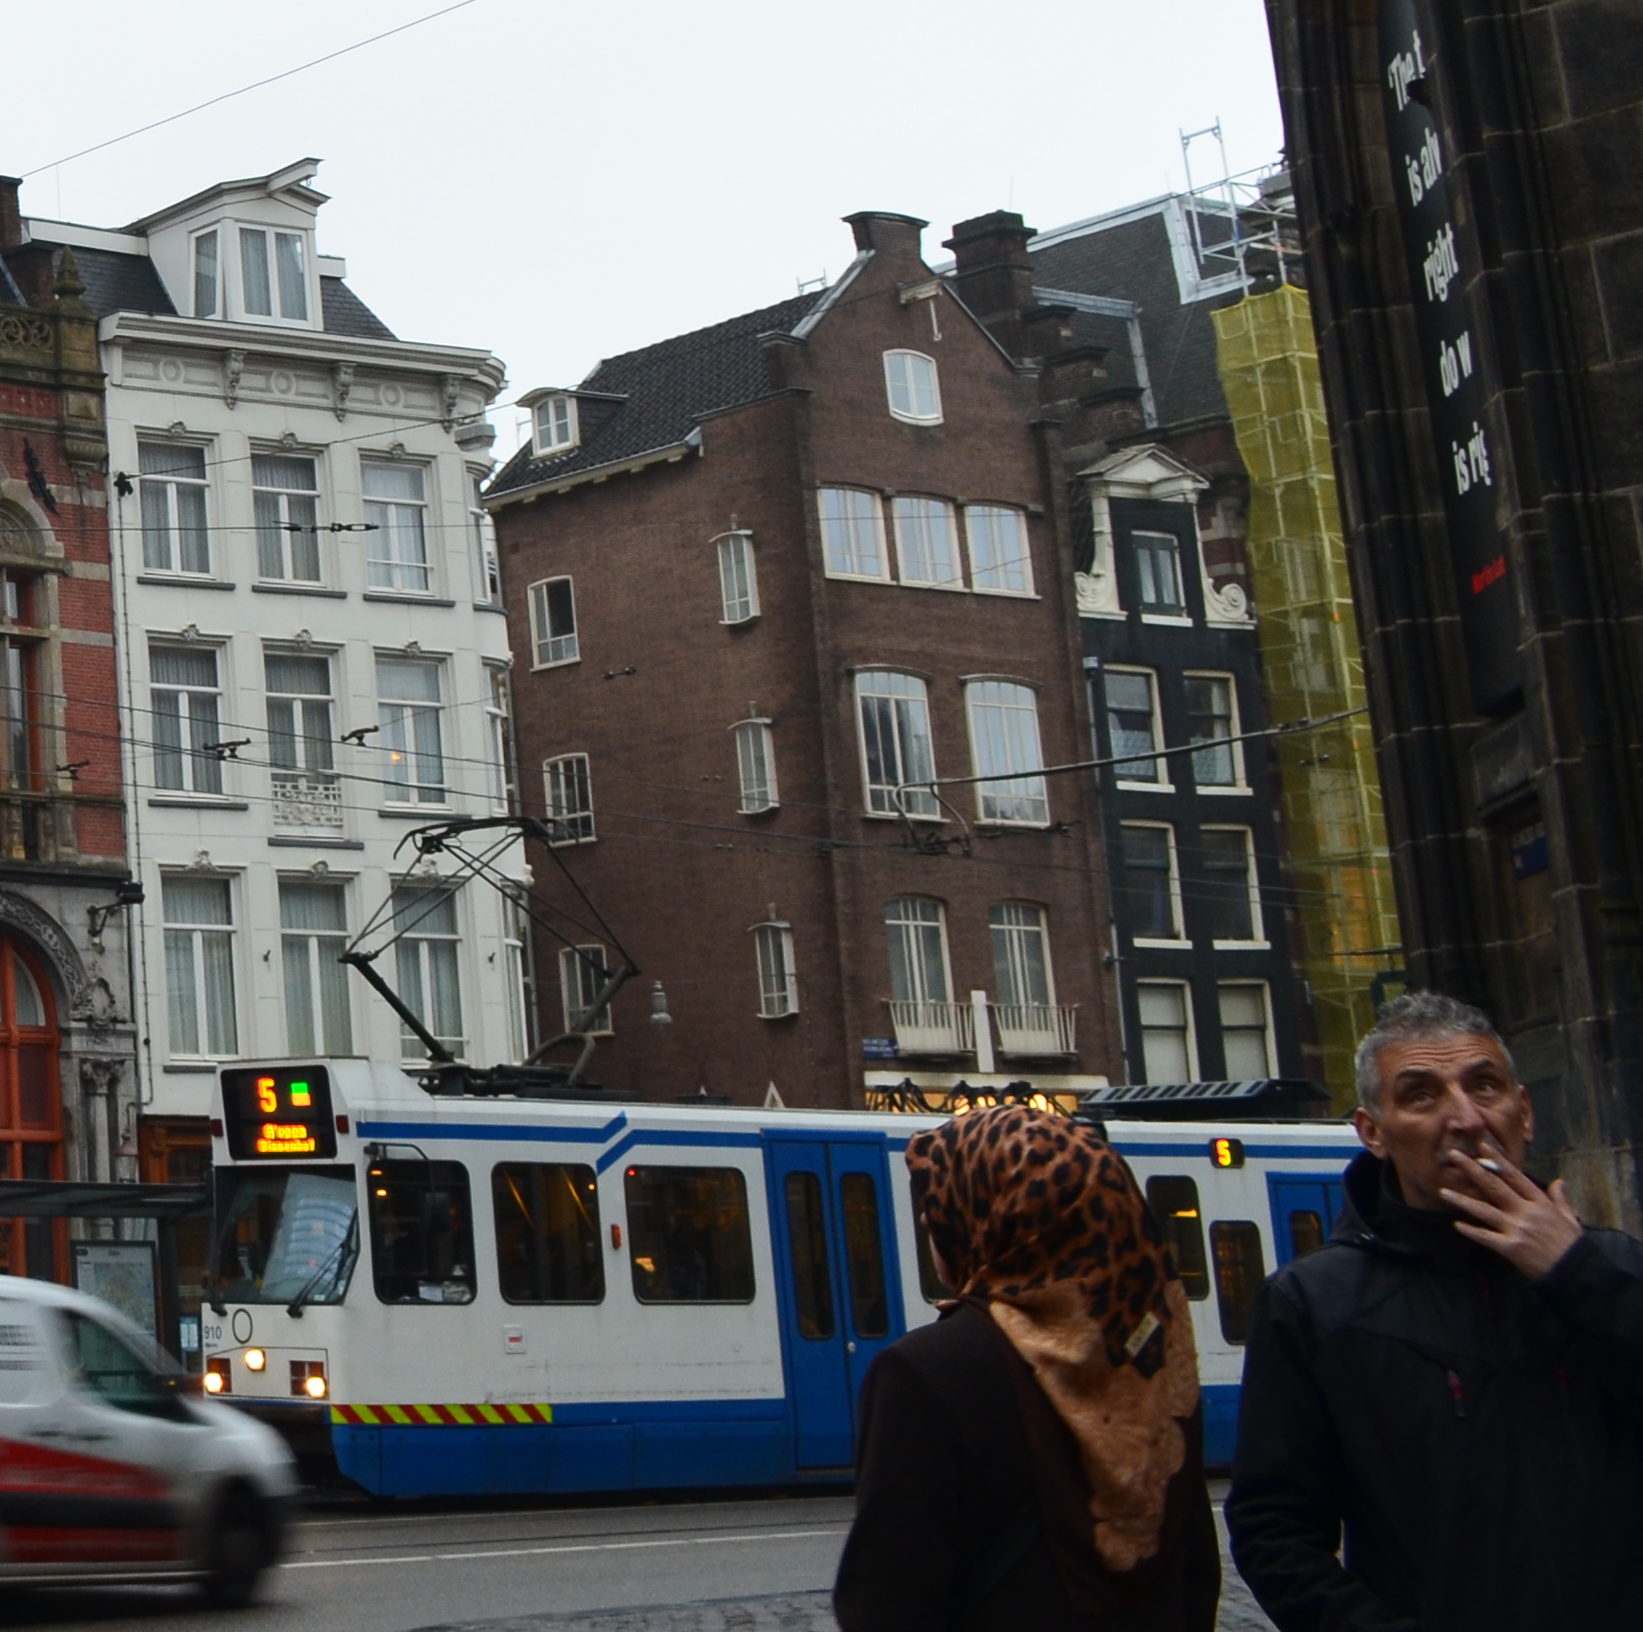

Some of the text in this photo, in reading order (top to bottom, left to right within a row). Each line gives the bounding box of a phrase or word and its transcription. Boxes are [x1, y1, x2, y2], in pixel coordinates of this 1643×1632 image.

[1405, 154, 1422, 207] is
[1423, 222, 1459, 302] right
[1440, 340, 1459, 397] do
[1452, 441, 1471, 495] is
[258, 1077, 277, 1112] 5
[1216, 1139, 1231, 1166] 5
[204, 1326, 222, 1339] 910
